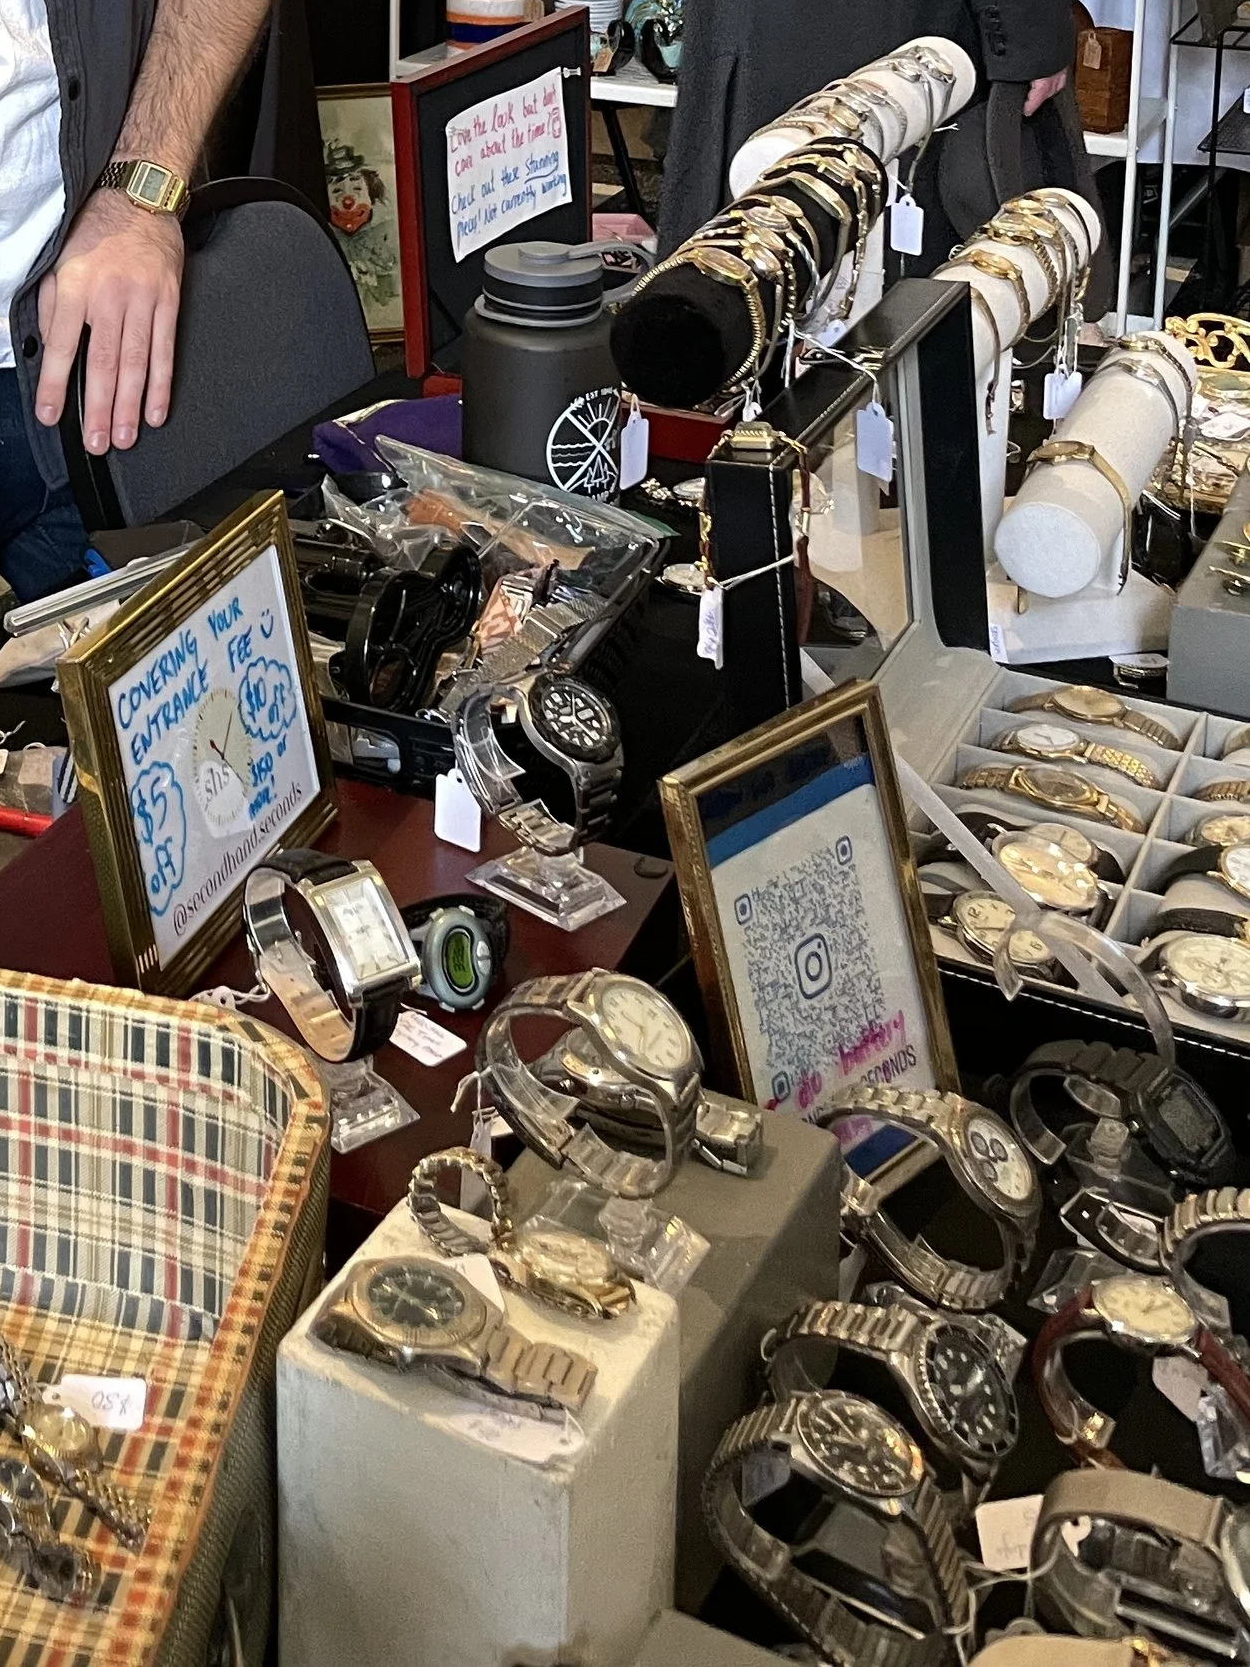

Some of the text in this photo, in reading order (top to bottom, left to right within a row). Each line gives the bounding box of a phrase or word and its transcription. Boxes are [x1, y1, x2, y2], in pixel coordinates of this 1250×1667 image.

[473, 114, 487, 137] the
[491, 101, 514, 132] look
[522, 94, 537, 118] but
[480, 133, 506, 159] about
[512, 127, 524, 148] the
[481, 168, 495, 198] out
[118, 597, 243, 730] COVERING YOUR
[131, 625, 253, 765] ENTRANCE FEE
[137, 775, 168, 847] $5
[205, 763, 230, 803] shs
[151, 835, 177, 895] off
[173, 782, 303, 937] @secondhand.seconds
